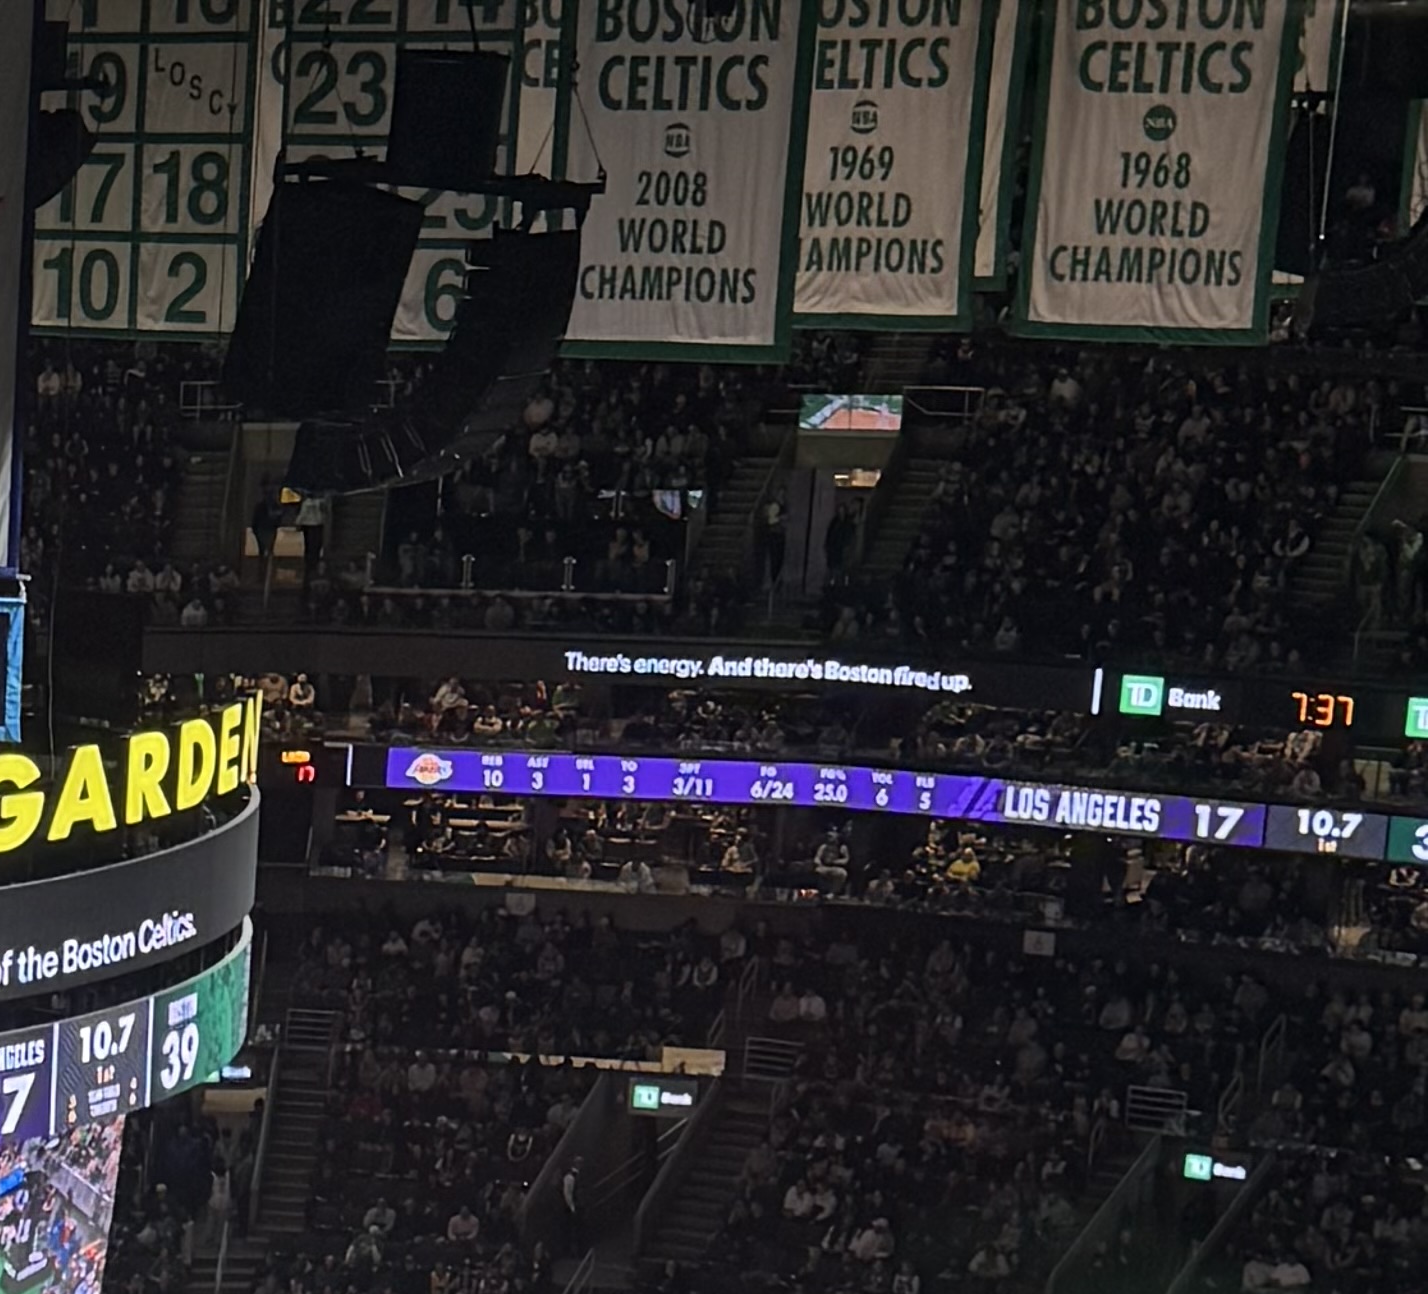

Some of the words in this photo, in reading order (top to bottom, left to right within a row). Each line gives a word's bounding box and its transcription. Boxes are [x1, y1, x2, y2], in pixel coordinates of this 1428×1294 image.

[598, 54, 771, 112] CELTICS
[814, 37, 952, 92] ELTICS
[1078, 40, 1255, 95] CELTICS
[293, 48, 388, 128] 23
[829, 144, 895, 182] 1969
[1119, 150, 1193, 190] 1968
[152, 149, 230, 227] 18
[635, 170, 708, 208] 2008
[804, 191, 912, 230] WORLD
[1093, 197, 1211, 240] WORLD
[617, 216, 727, 256] WORLD
[579, 264, 758, 305] CHAMPIONS
[1049, 244, 1244, 287] CHAMPIONS
[42, 246, 120, 321] 10
[163, 252, 208, 324] 2
[422, 257, 468, 334] 6
[565, 650, 633, 674] There's
[633, 654, 705, 678] energy.
[707, 655, 753, 679] And
[754, 657, 824, 681] there's
[825, 660, 893, 686] Boston
[893, 664, 941, 690] fired
[941, 672, 973, 694] up.
[1125, 681, 1156, 708] TD
[1168, 687, 1222, 711] Bank
[1291, 691, 1354, 727] 7:37
[483, 770, 504, 788] 10
[671, 777, 714, 798] 3/11
[750, 779, 795, 800] 6/24
[813, 783, 848, 803] 25.0
[1003, 789, 1048, 821] LOS
[1055, 790, 1161, 833] ANGELES
[1194, 805, 1245, 840] 17
[1296, 809, 1363, 839] 10.7
[17, 945, 60, 985] the
[62, 930, 137, 974] Boston
[137, 909, 198, 956] Celtics.
[79, 1012, 136, 1064] 10.7
[159, 1022, 200, 1091] 39
